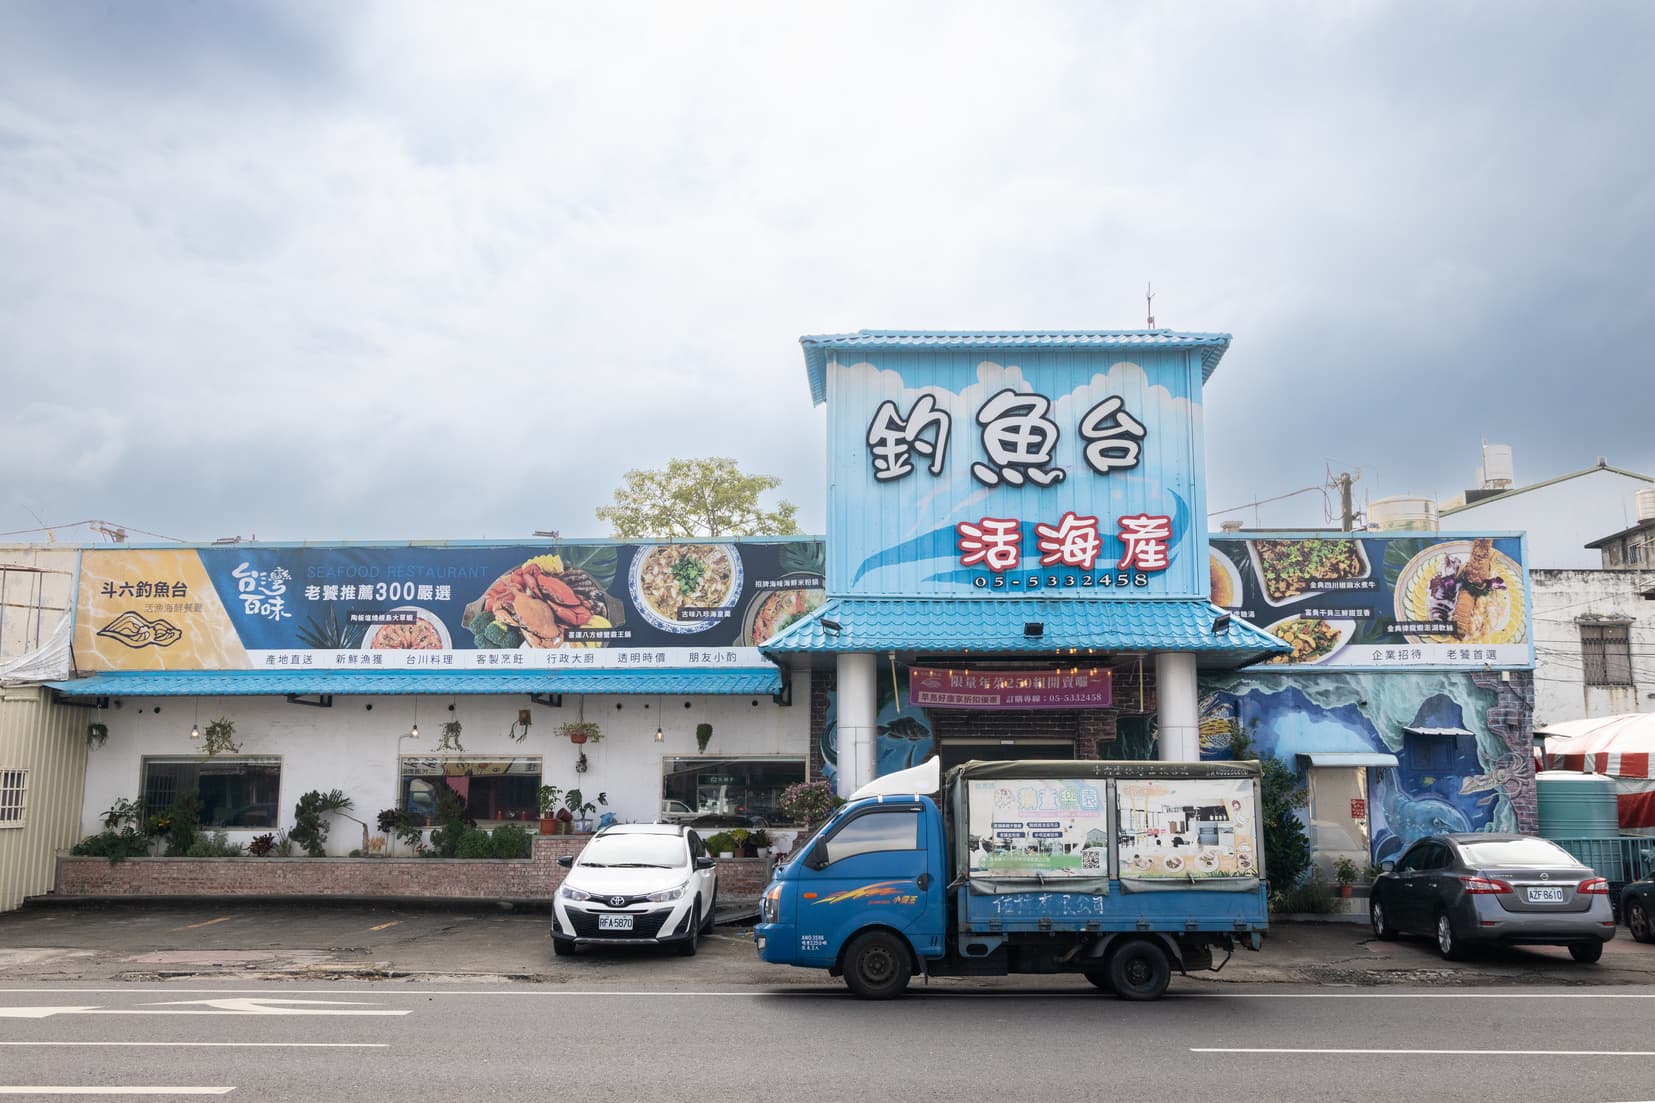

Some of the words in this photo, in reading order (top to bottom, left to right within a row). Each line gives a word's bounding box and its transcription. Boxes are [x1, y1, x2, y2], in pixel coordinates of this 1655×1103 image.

[867, 388, 1147, 488] 釣魚台
[957, 512, 1172, 573] 活海產
[307, 566, 380, 578] SEAFOOD
[387, 565, 489, 577] RESTAURANT
[974, 573, 1150, 588] 05-5332458
[101, 581, 188, 598] 斗六釣魚台
[265, 655, 313, 665] 產地直送
[336, 655, 383, 665] 新鮮漁獲
[406, 655, 453, 665] 台川料理
[476, 654, 524, 665] 客製烹飪
[547, 654, 594, 664] 行政大廚
[617, 653, 666, 664] 透明時價
[689, 652, 737, 663] 朋友小酌
[1372, 649, 1422, 661] 企業招待
[1447, 648, 1497, 660] 老饕首選
